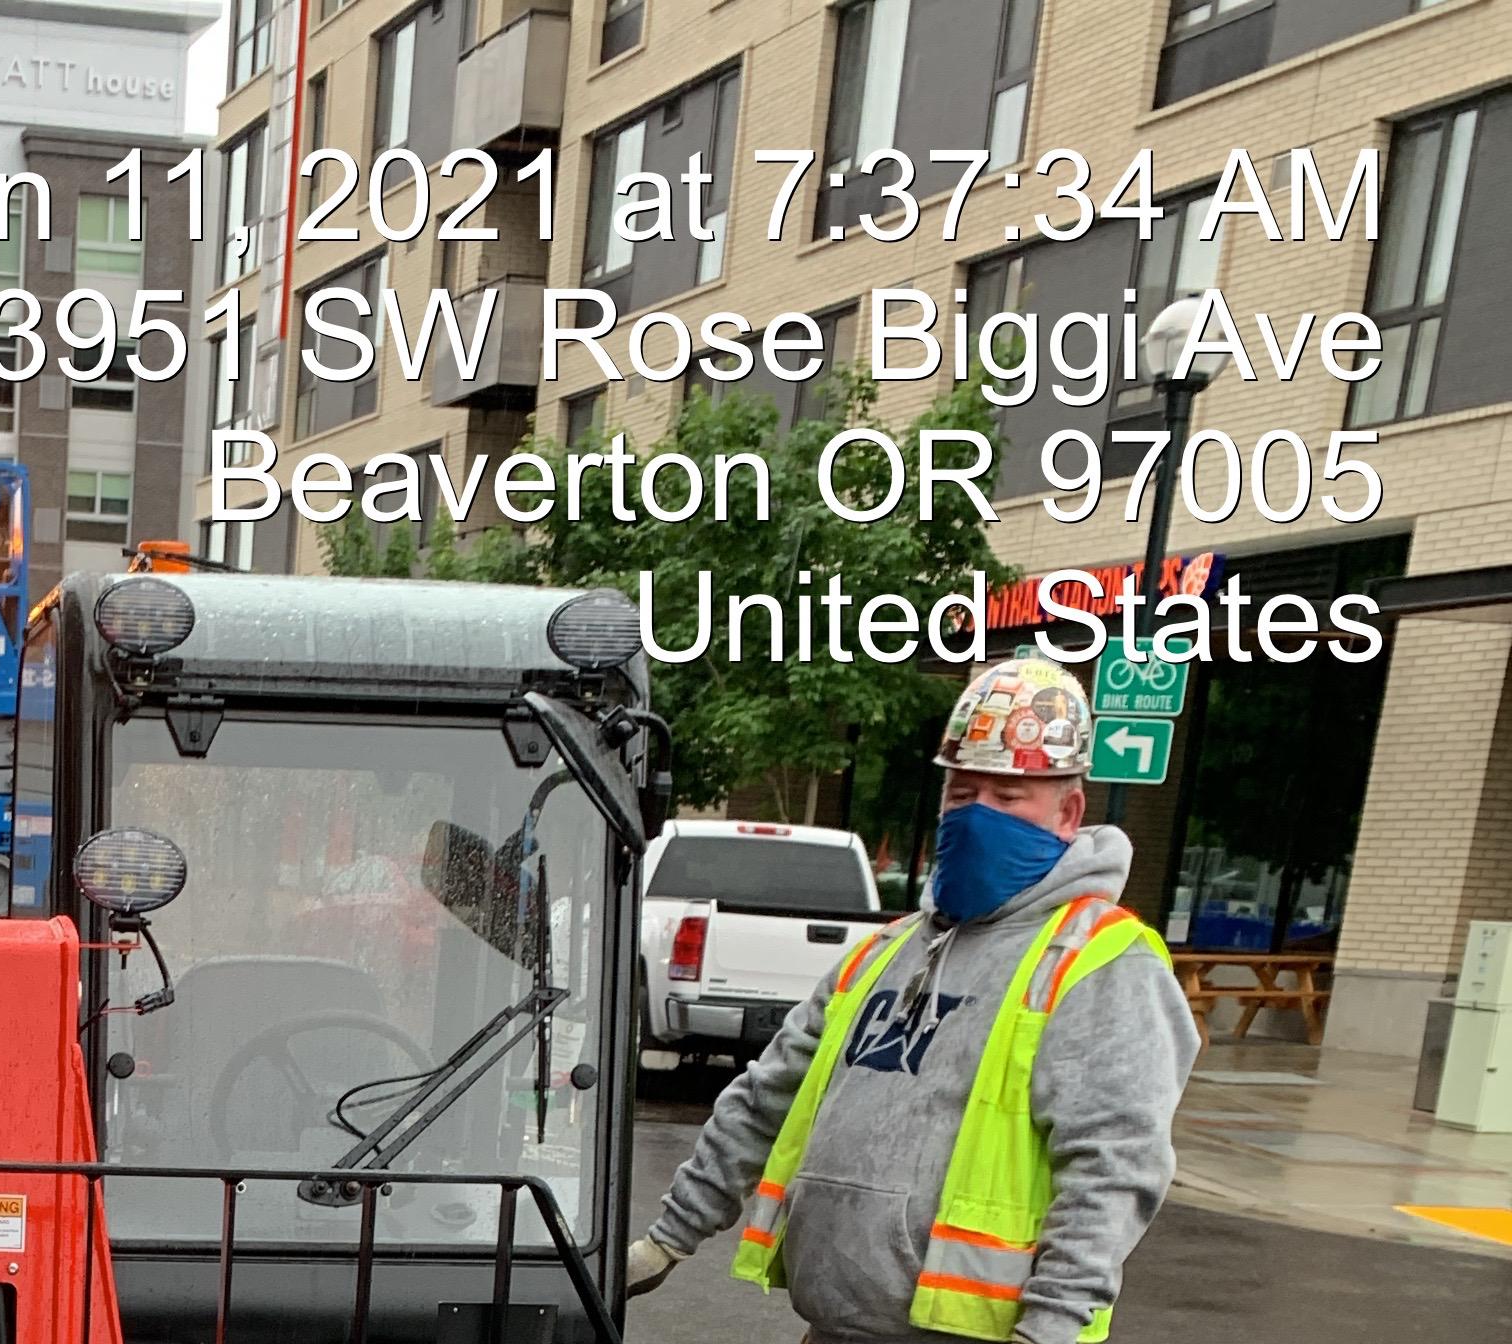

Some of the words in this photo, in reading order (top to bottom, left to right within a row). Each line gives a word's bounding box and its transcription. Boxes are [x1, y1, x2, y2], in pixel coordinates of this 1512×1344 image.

[87, 65, 176, 101] house
[1101, 692, 1129, 710] BIKE
[1133, 693, 1174, 711] ROUTE
[844, 988, 966, 1077] CAT
